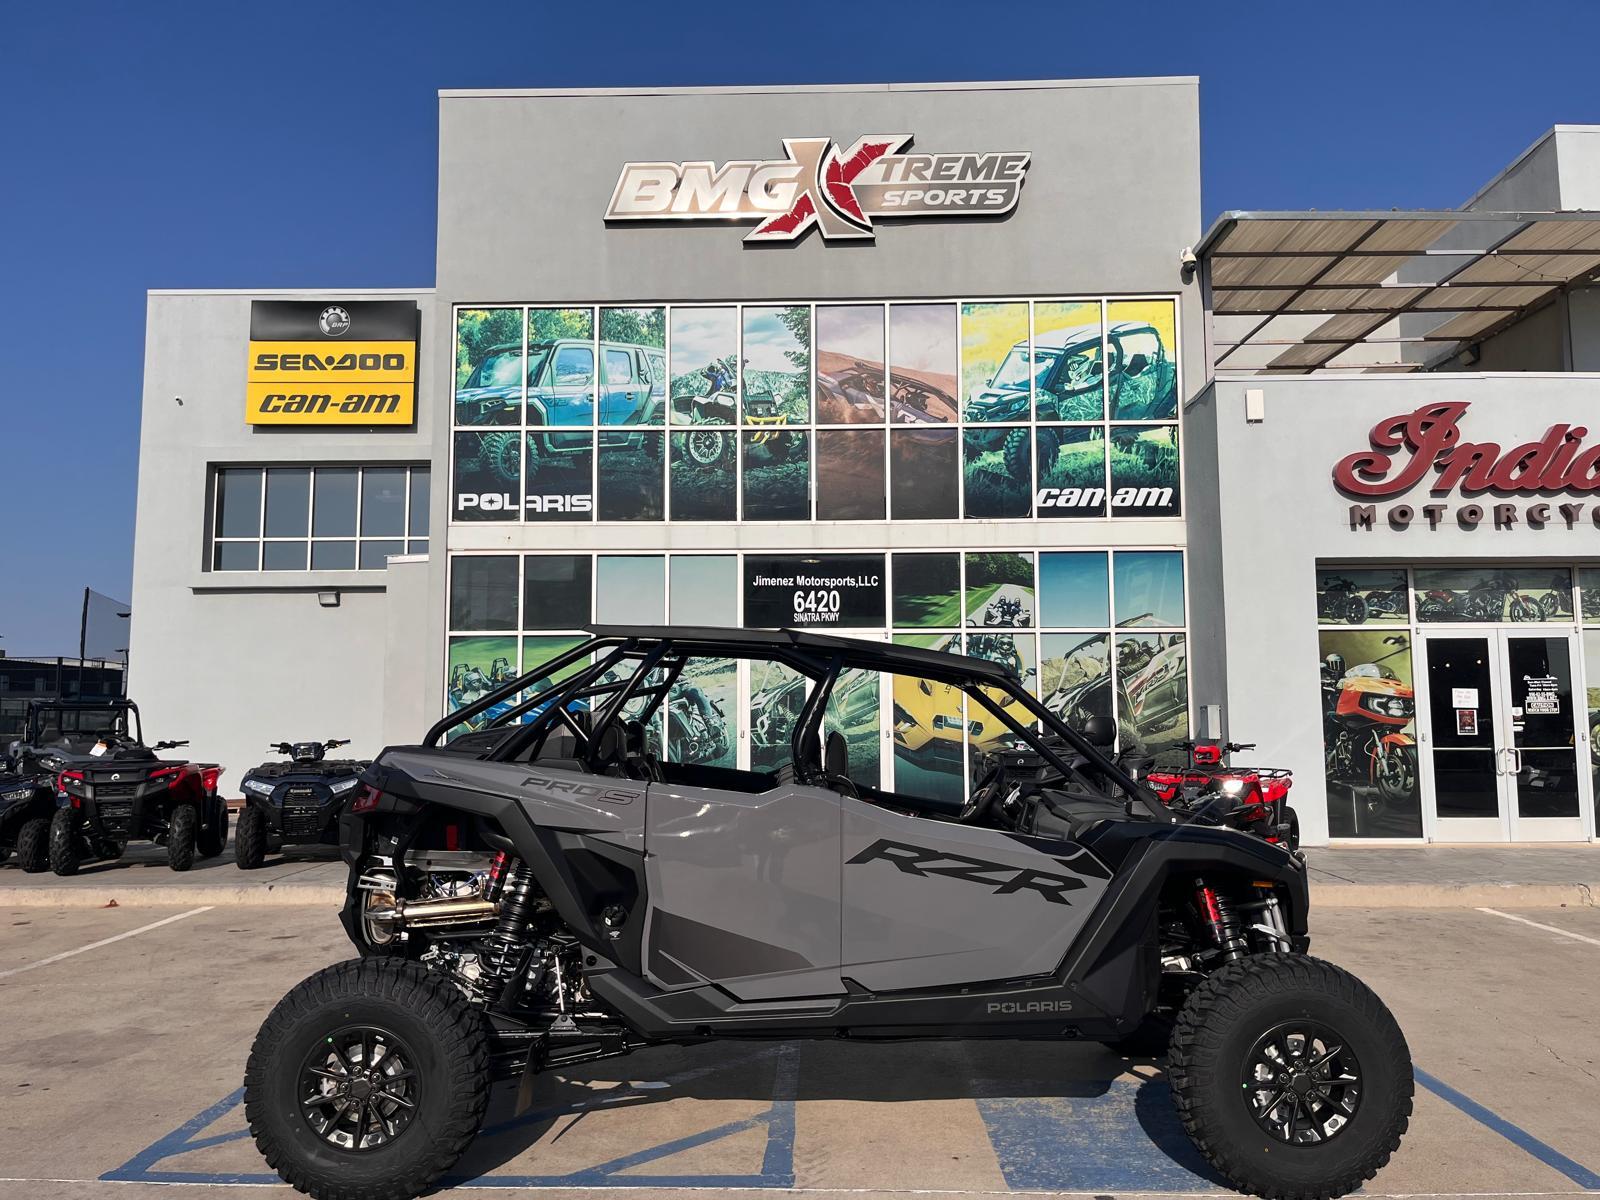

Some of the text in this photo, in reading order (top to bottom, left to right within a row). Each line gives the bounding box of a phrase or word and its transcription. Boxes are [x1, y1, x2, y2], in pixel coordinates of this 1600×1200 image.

[614, 163, 804, 213] BMG
[881, 187, 1008, 208] SPORTS
[259, 394, 401, 414] can-am
[458, 493, 592, 513] POLARIS
[752, 575, 879, 589] Jimenez Motorsports,LLC
[793, 590, 841, 613] 6420
[793, 612, 840, 622] SINATRA PKWY
[520, 777, 602, 797] PRO
[844, 838, 1088, 906] RZR
[987, 1000, 1073, 1014] POLARIS
